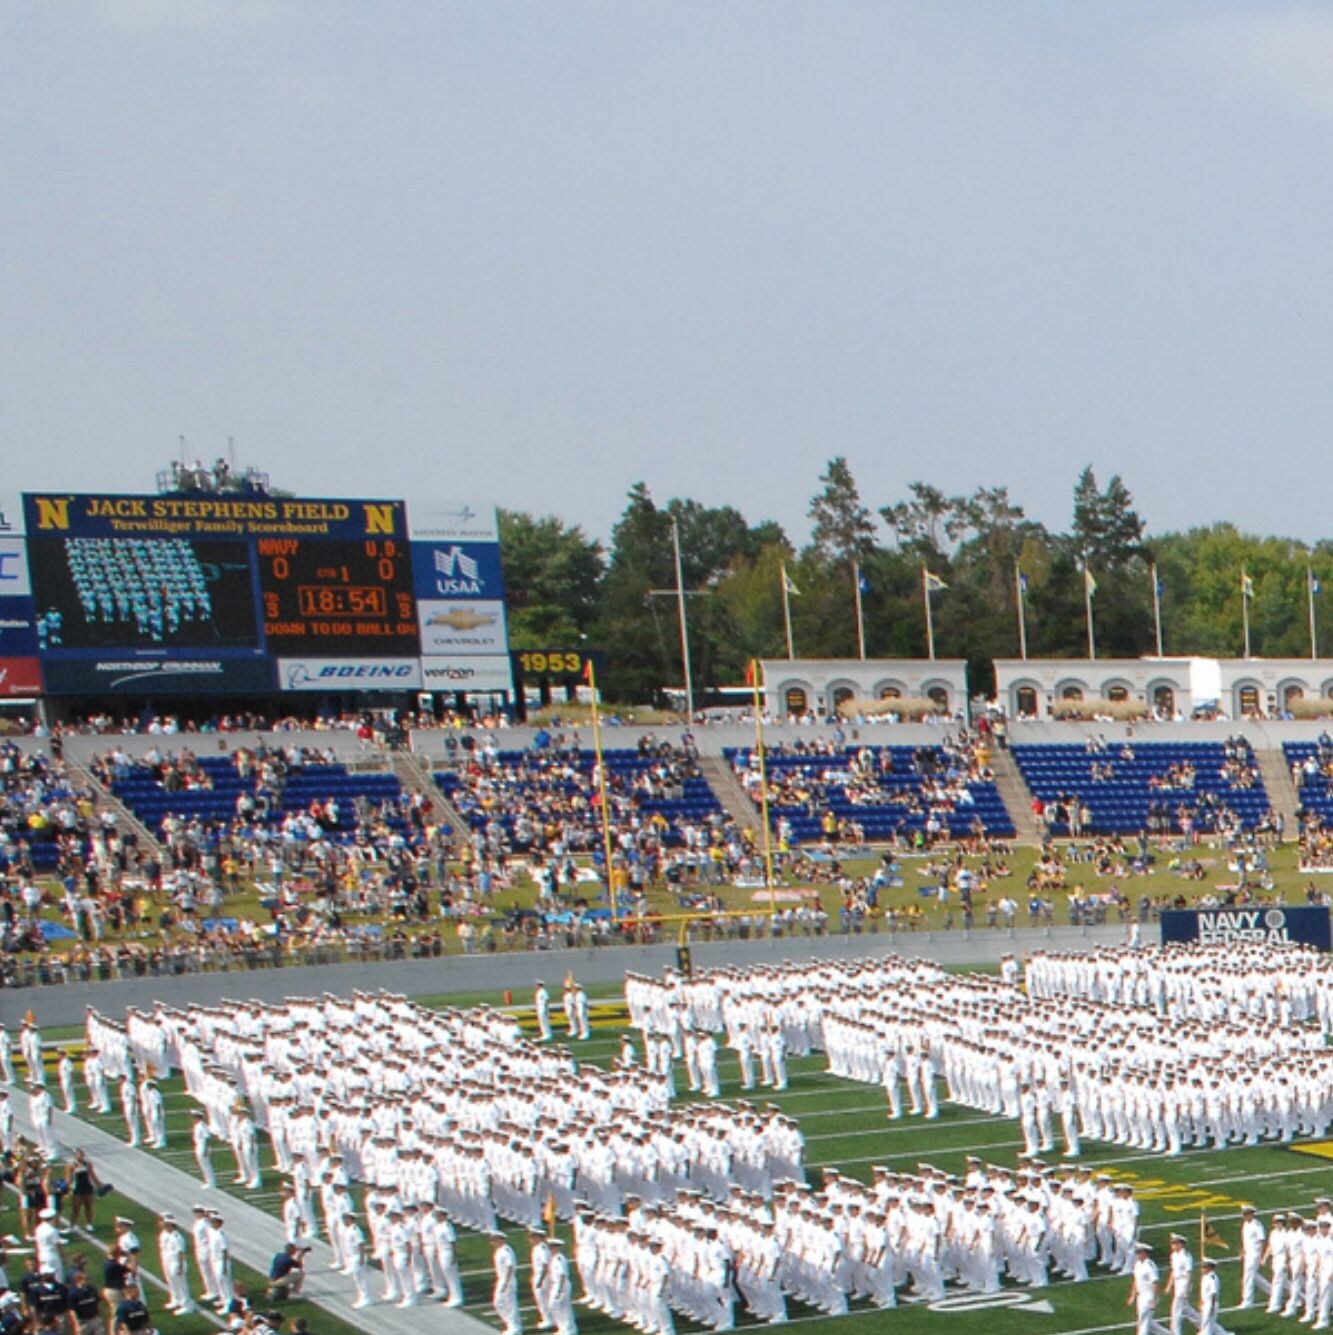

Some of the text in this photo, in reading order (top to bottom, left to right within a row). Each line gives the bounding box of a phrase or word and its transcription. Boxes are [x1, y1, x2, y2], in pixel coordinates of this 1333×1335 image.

[36, 496, 69, 530] N
[86, 500, 350, 520] JACK STEPHENS FIELD
[363, 505, 395, 534] N
[249, 522, 329, 534] Scoreboard
[273, 557, 289, 580] 0
[378, 558, 395, 581] 0
[437, 580, 481, 594] USAA
[305, 590, 380, 614] 18:54
[318, 663, 413, 679] BOEING
[519, 652, 581, 673] 1953
[1199, 911, 1260, 930] NAVY
